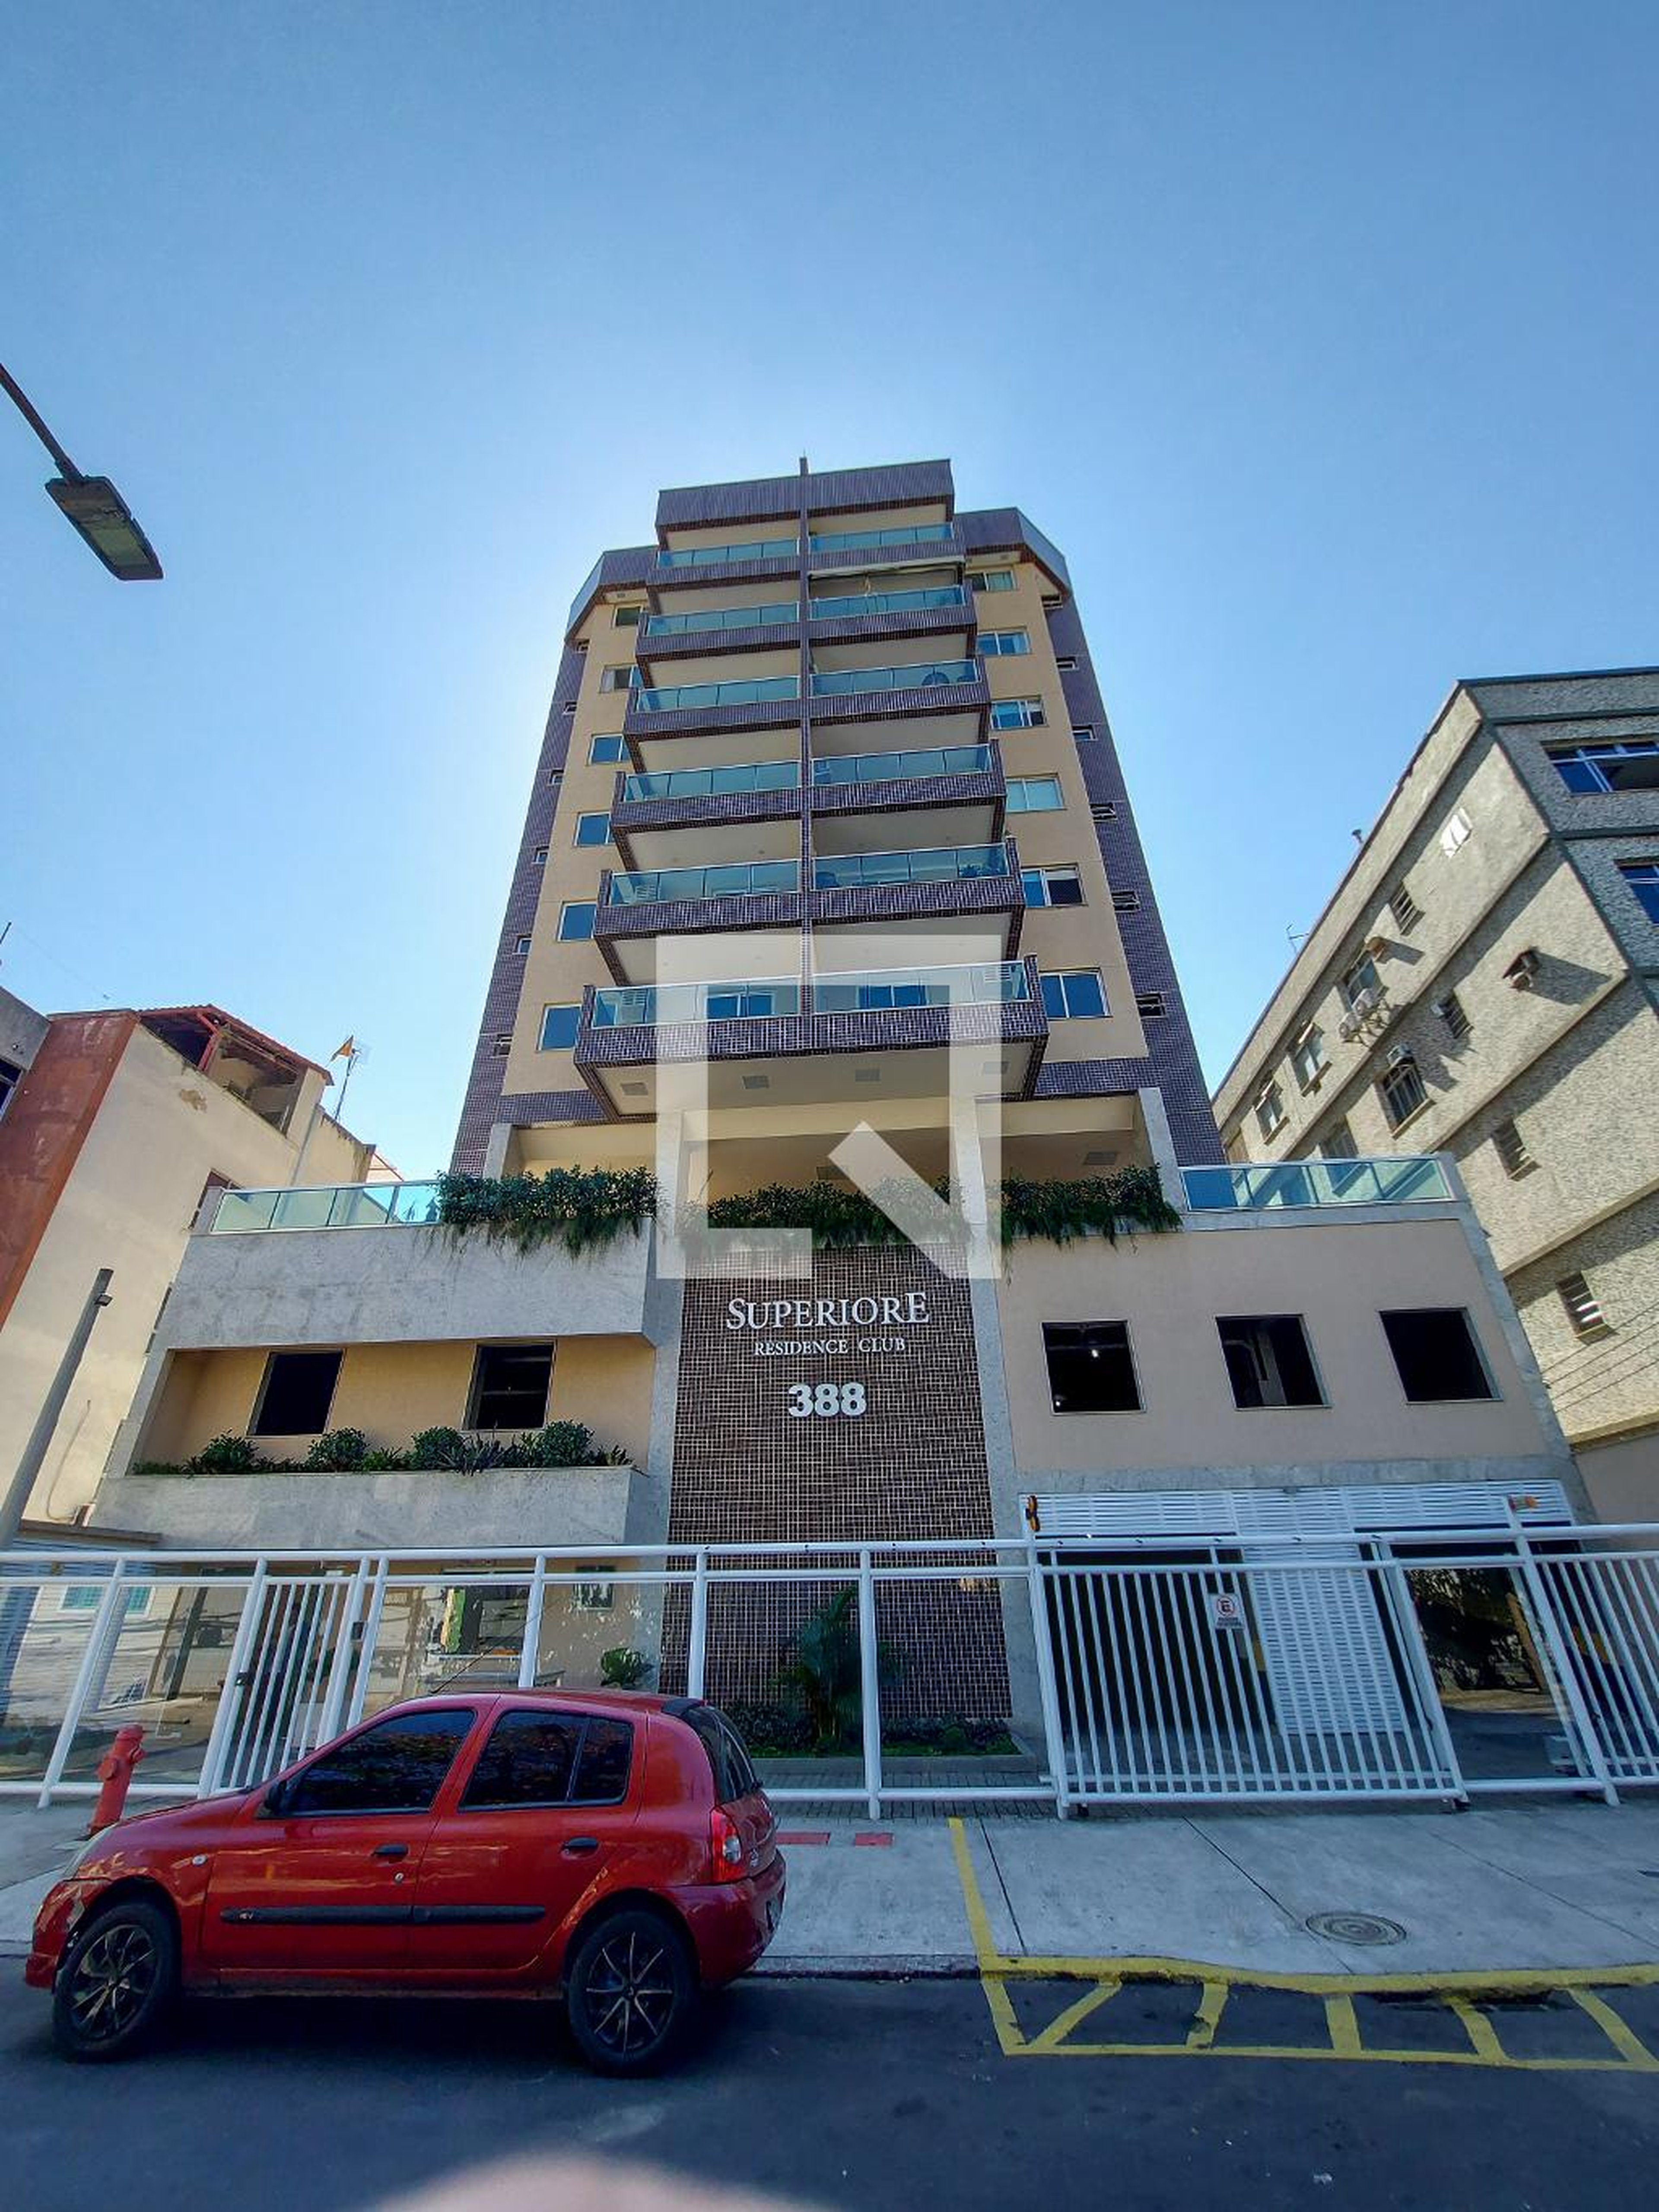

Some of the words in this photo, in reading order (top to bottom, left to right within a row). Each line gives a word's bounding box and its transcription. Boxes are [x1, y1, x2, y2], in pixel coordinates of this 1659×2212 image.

[727, 1292, 929, 1329] SUPERIORE
[755, 1340, 849, 1356] RESIDENCE
[859, 1338, 906, 1352] CLUB
[788, 1382, 867, 1418] 388
